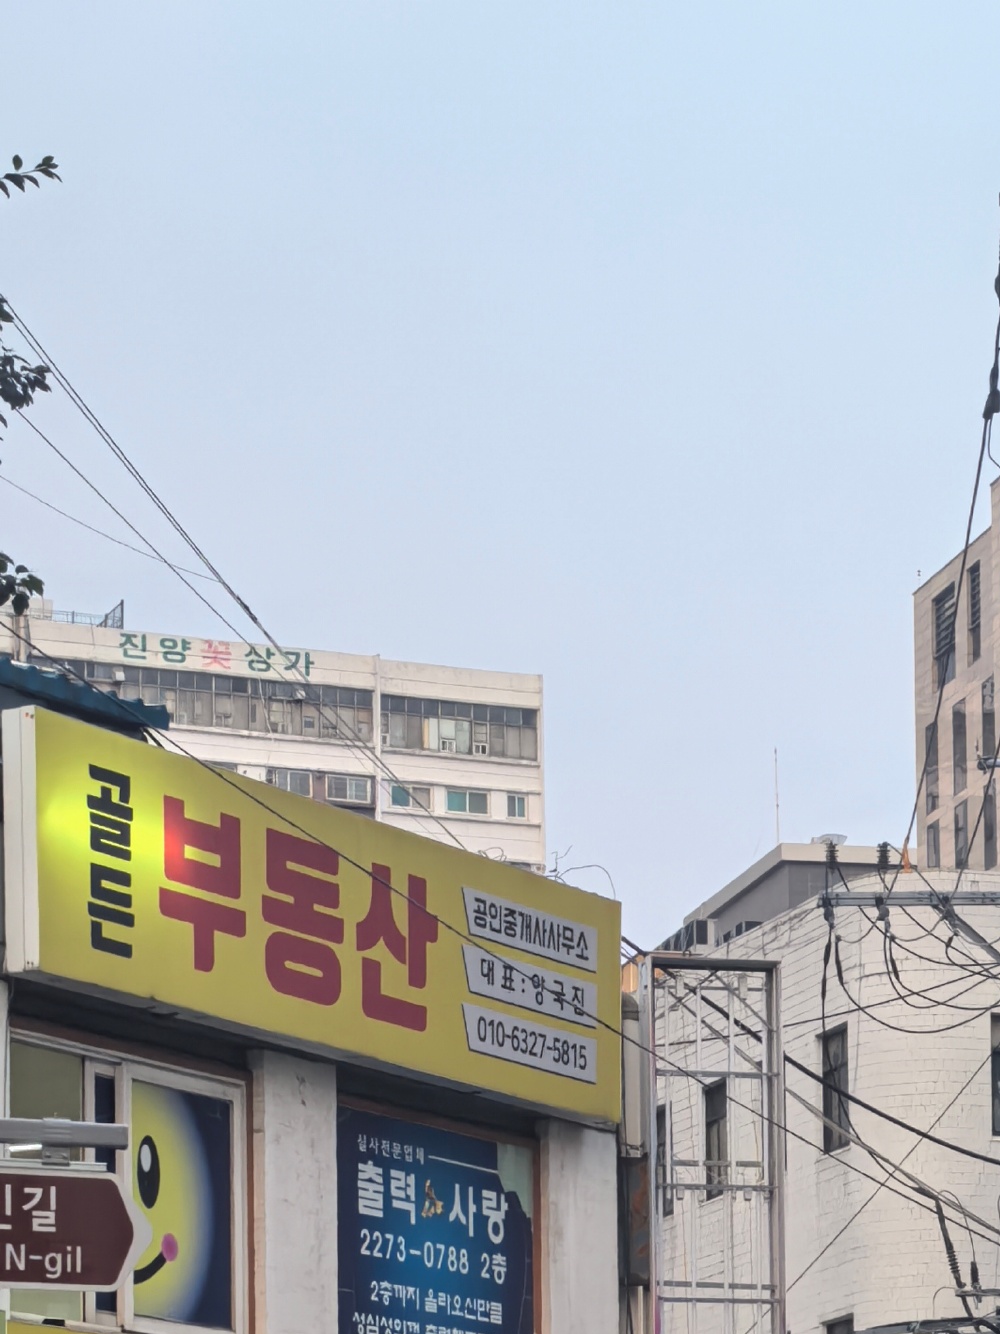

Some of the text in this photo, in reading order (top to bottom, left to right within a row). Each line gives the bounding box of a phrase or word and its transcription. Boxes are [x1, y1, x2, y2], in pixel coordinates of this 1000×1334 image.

[87, 763, 134, 959] 골든
[158, 794, 438, 1033] 부동산
[473, 897, 590, 961] 공인중개사사무소
[477, 1016, 588, 1071] 010-6327-5815
[357, 1160, 508, 1245] 출력 사랑
[5, 1243, 82, 1279] N-gil
[360, 1228, 507, 1285] 2273-0788 2층
[370, 1280, 420, 1311] 2층까지
